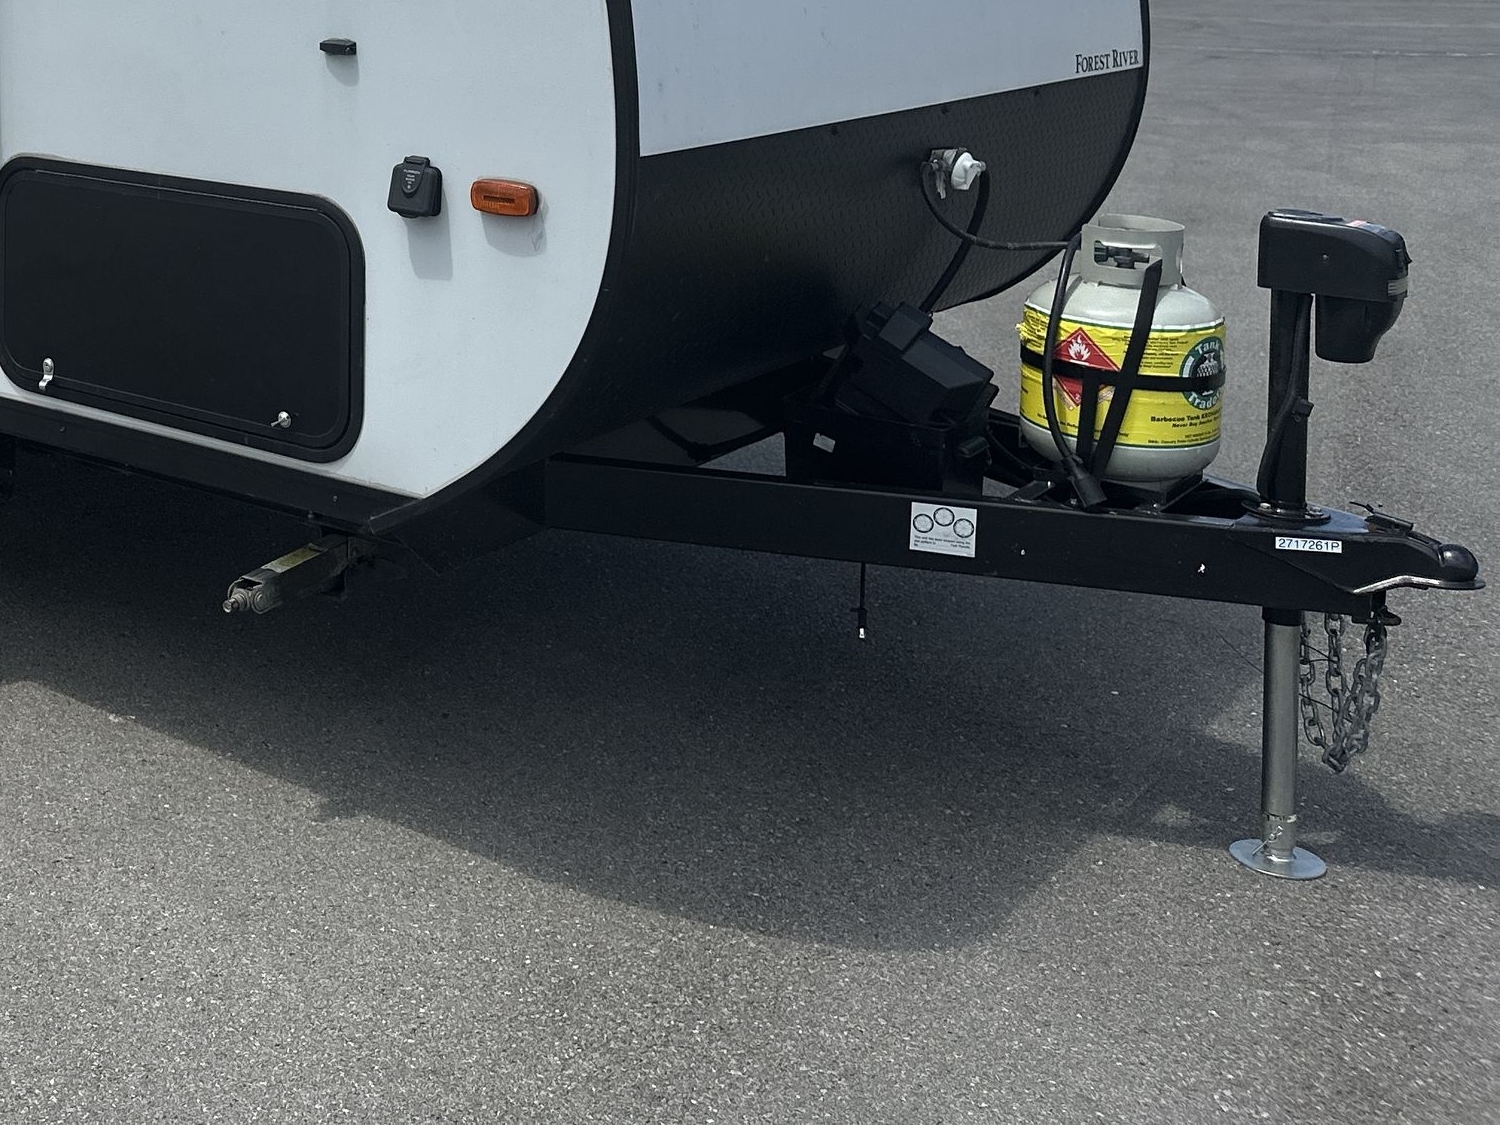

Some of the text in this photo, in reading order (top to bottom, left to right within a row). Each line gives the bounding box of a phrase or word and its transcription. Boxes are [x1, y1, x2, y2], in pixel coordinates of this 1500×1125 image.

[1075, 49, 1140, 74] FOREST RIVER
[1195, 339, 1221, 355] Tank
[1278, 538, 1340, 551] 2717261P
